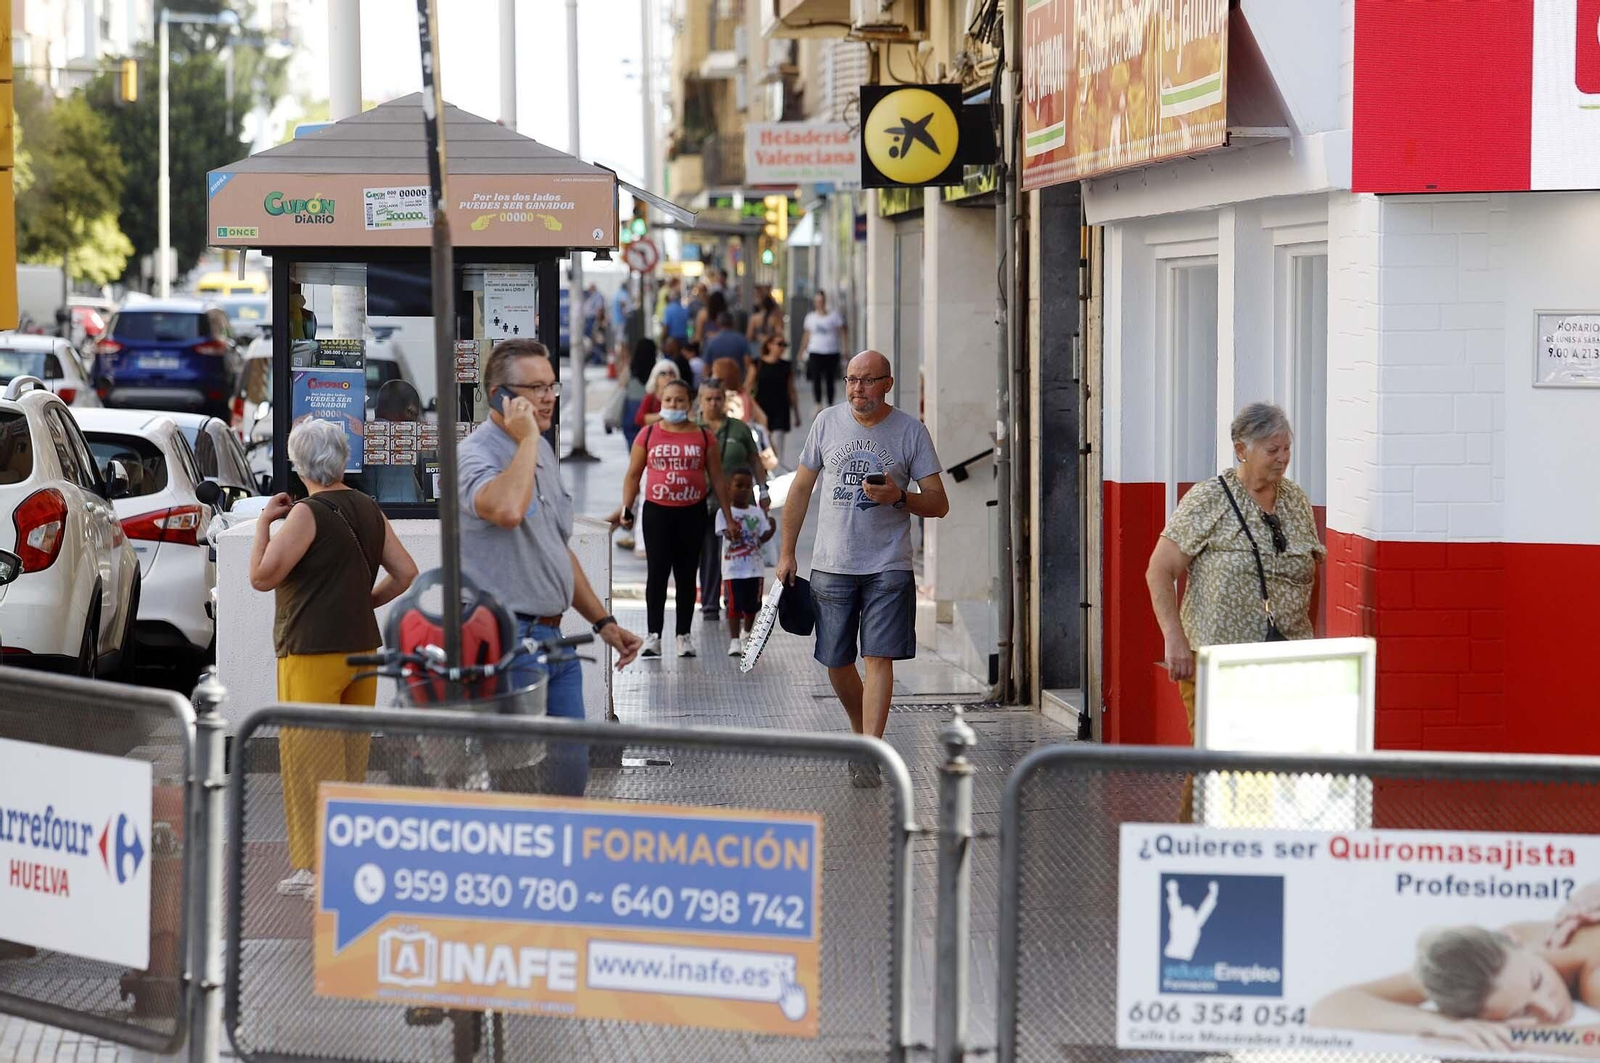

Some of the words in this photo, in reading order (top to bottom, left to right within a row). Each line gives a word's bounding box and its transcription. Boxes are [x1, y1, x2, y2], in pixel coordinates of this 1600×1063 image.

[399, 189, 427, 198] 00000
[473, 193, 492, 201] Por
[494, 193, 510, 201] los
[512, 193, 531, 201] dos
[533, 193, 561, 201] lados
[459, 202, 500, 210] PUEDES
[503, 202, 523, 210] SER
[525, 202, 575, 210] GANADOR
[500, 212, 534, 222] 00000
[229, 228, 256, 237] ONCE
[1557, 322, 1600, 333] HORARIO
[1548, 347, 1569, 358] 9.00
[1572, 348, 1579, 358] A
[684, 444, 701, 457] ME
[831, 440, 878, 466] ORIGINAL
[878, 449, 895, 466] DIV
[668, 457, 689, 471] TELL
[832, 486, 853, 501] Blue
[328, 814, 556, 858] OPOSICIONES
[581, 827, 809, 871] FORMACIÓN
[1138, 834, 1264, 861] ¿Quieres
[1274, 840, 1318, 858] ser
[1329, 836, 1577, 871] Quiromasajista
[10, 858, 70, 898] HUELVA
[1396, 873, 1576, 900] Profesional?
[393, 868, 449, 902] 959
[454, 872, 513, 907] 830
[518, 877, 579, 912] 780
[611, 883, 675, 919] 640
[680, 887, 741, 924] 798
[747, 891, 805, 930] 742
[440, 940, 578, 992] INAFE
[593, 954, 771, 988] www.inafe.es
[1128, 1001, 1181, 1023] 606
[1191, 1003, 1244, 1025] 354
[1254, 1005, 1307, 1027] 054
